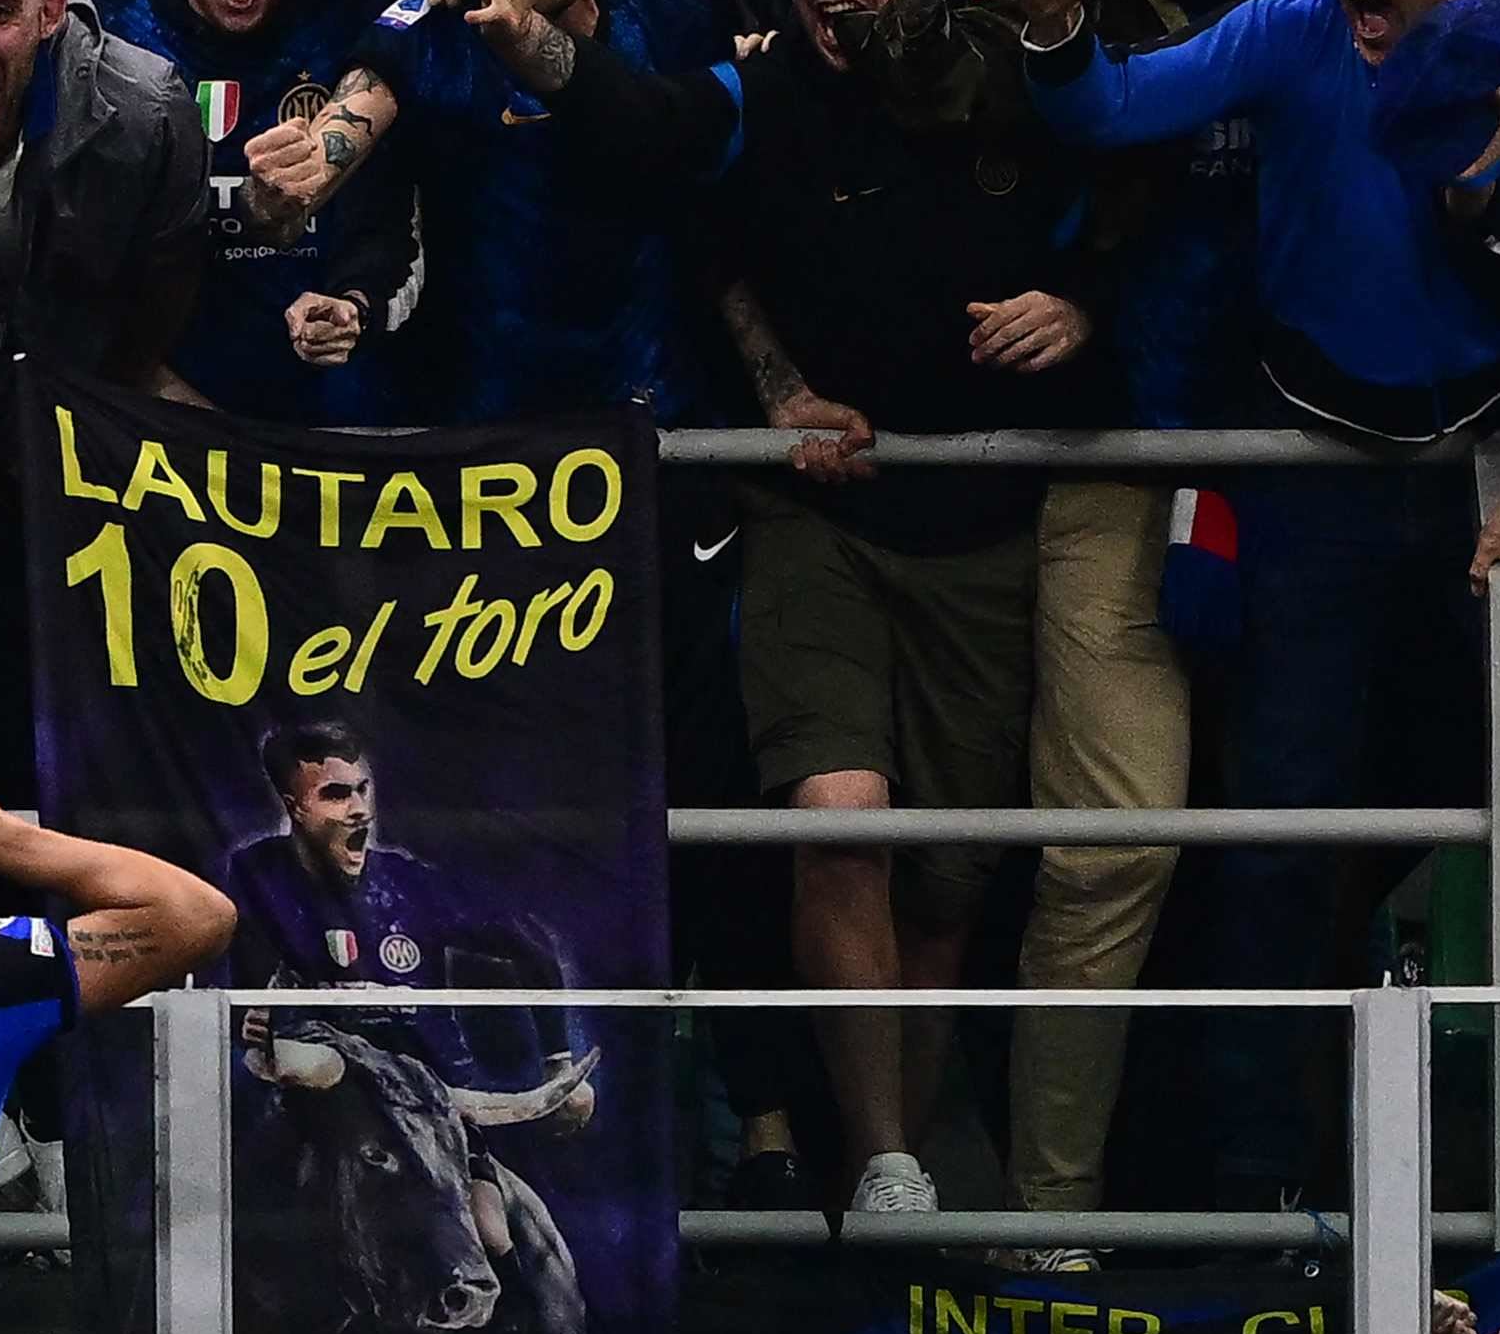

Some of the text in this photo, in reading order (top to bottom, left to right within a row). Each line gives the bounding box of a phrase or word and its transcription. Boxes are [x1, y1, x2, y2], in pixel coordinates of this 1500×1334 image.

[53, 404, 624, 551] LAUTARO
[65, 520, 615, 708] 10 el toro
